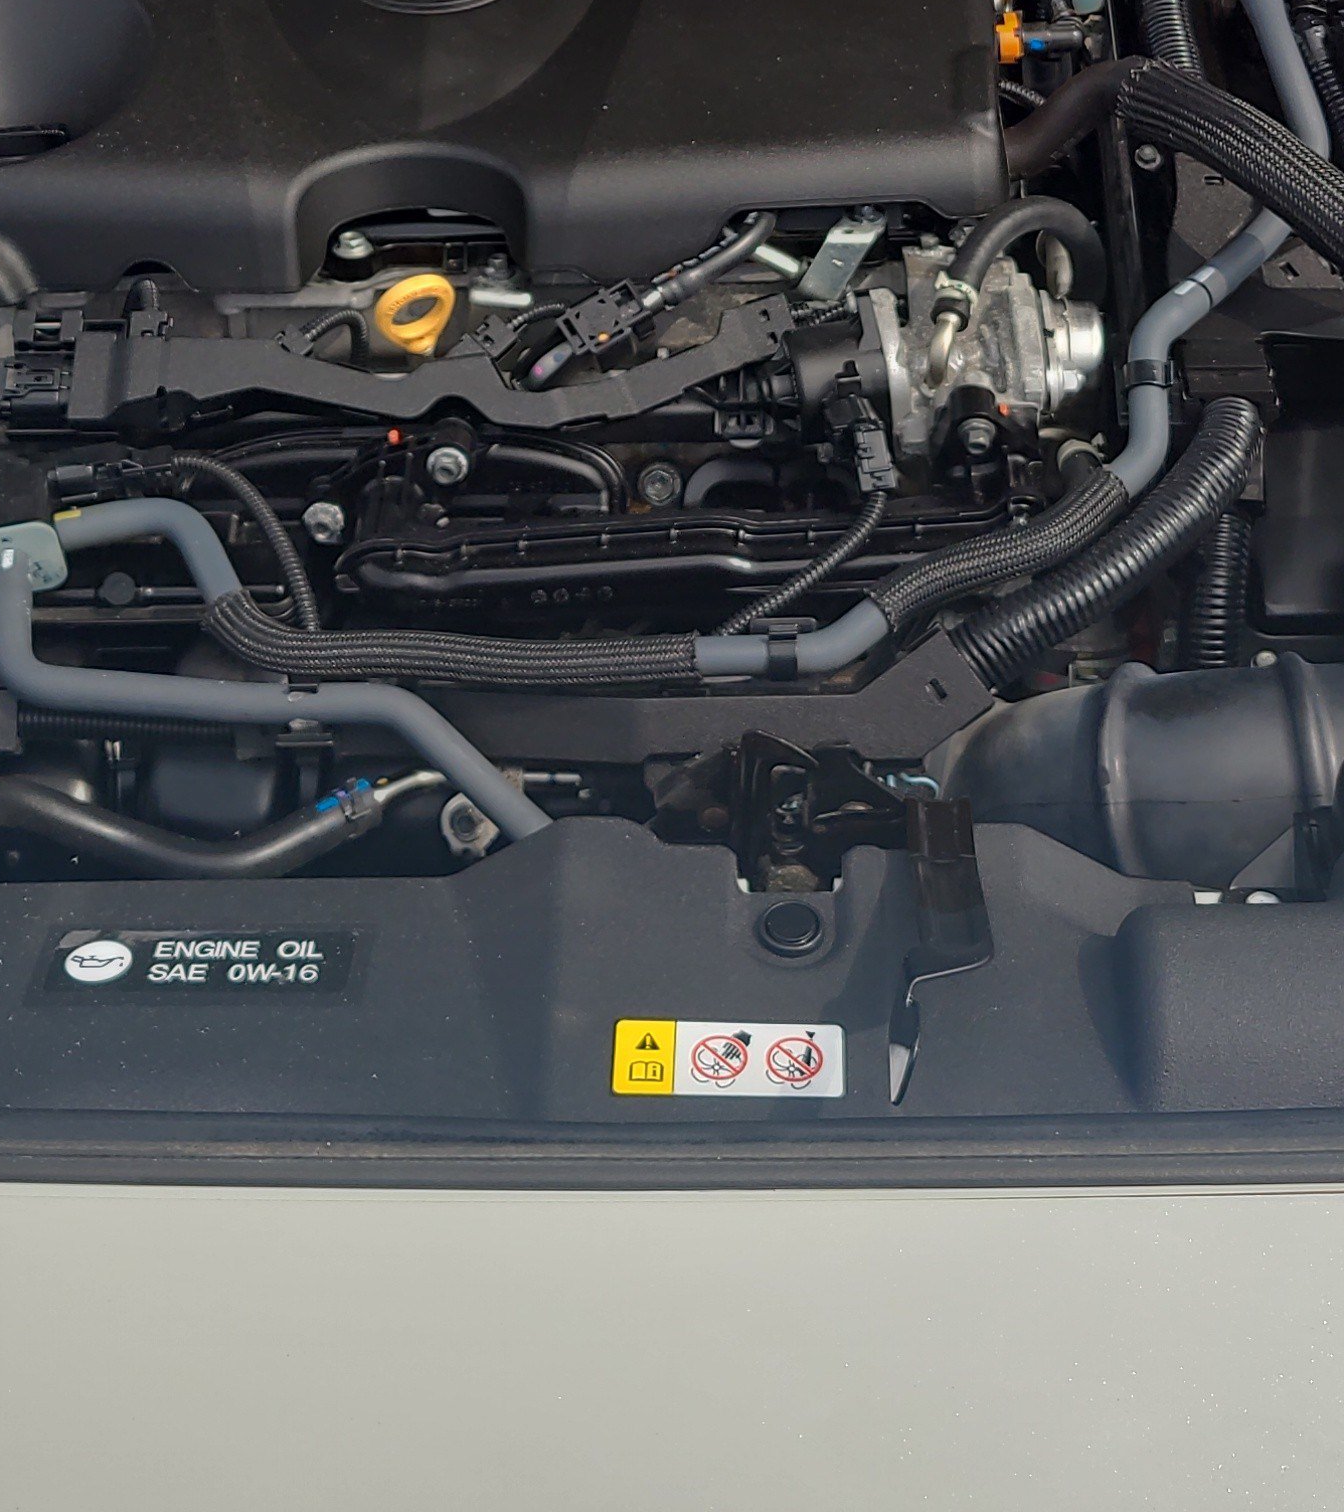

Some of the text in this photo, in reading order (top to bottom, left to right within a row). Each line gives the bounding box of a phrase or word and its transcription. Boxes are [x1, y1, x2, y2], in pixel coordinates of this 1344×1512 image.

[152, 940, 324, 959] ENGINE OIL
[146, 963, 321, 983] SAE 0W-16
